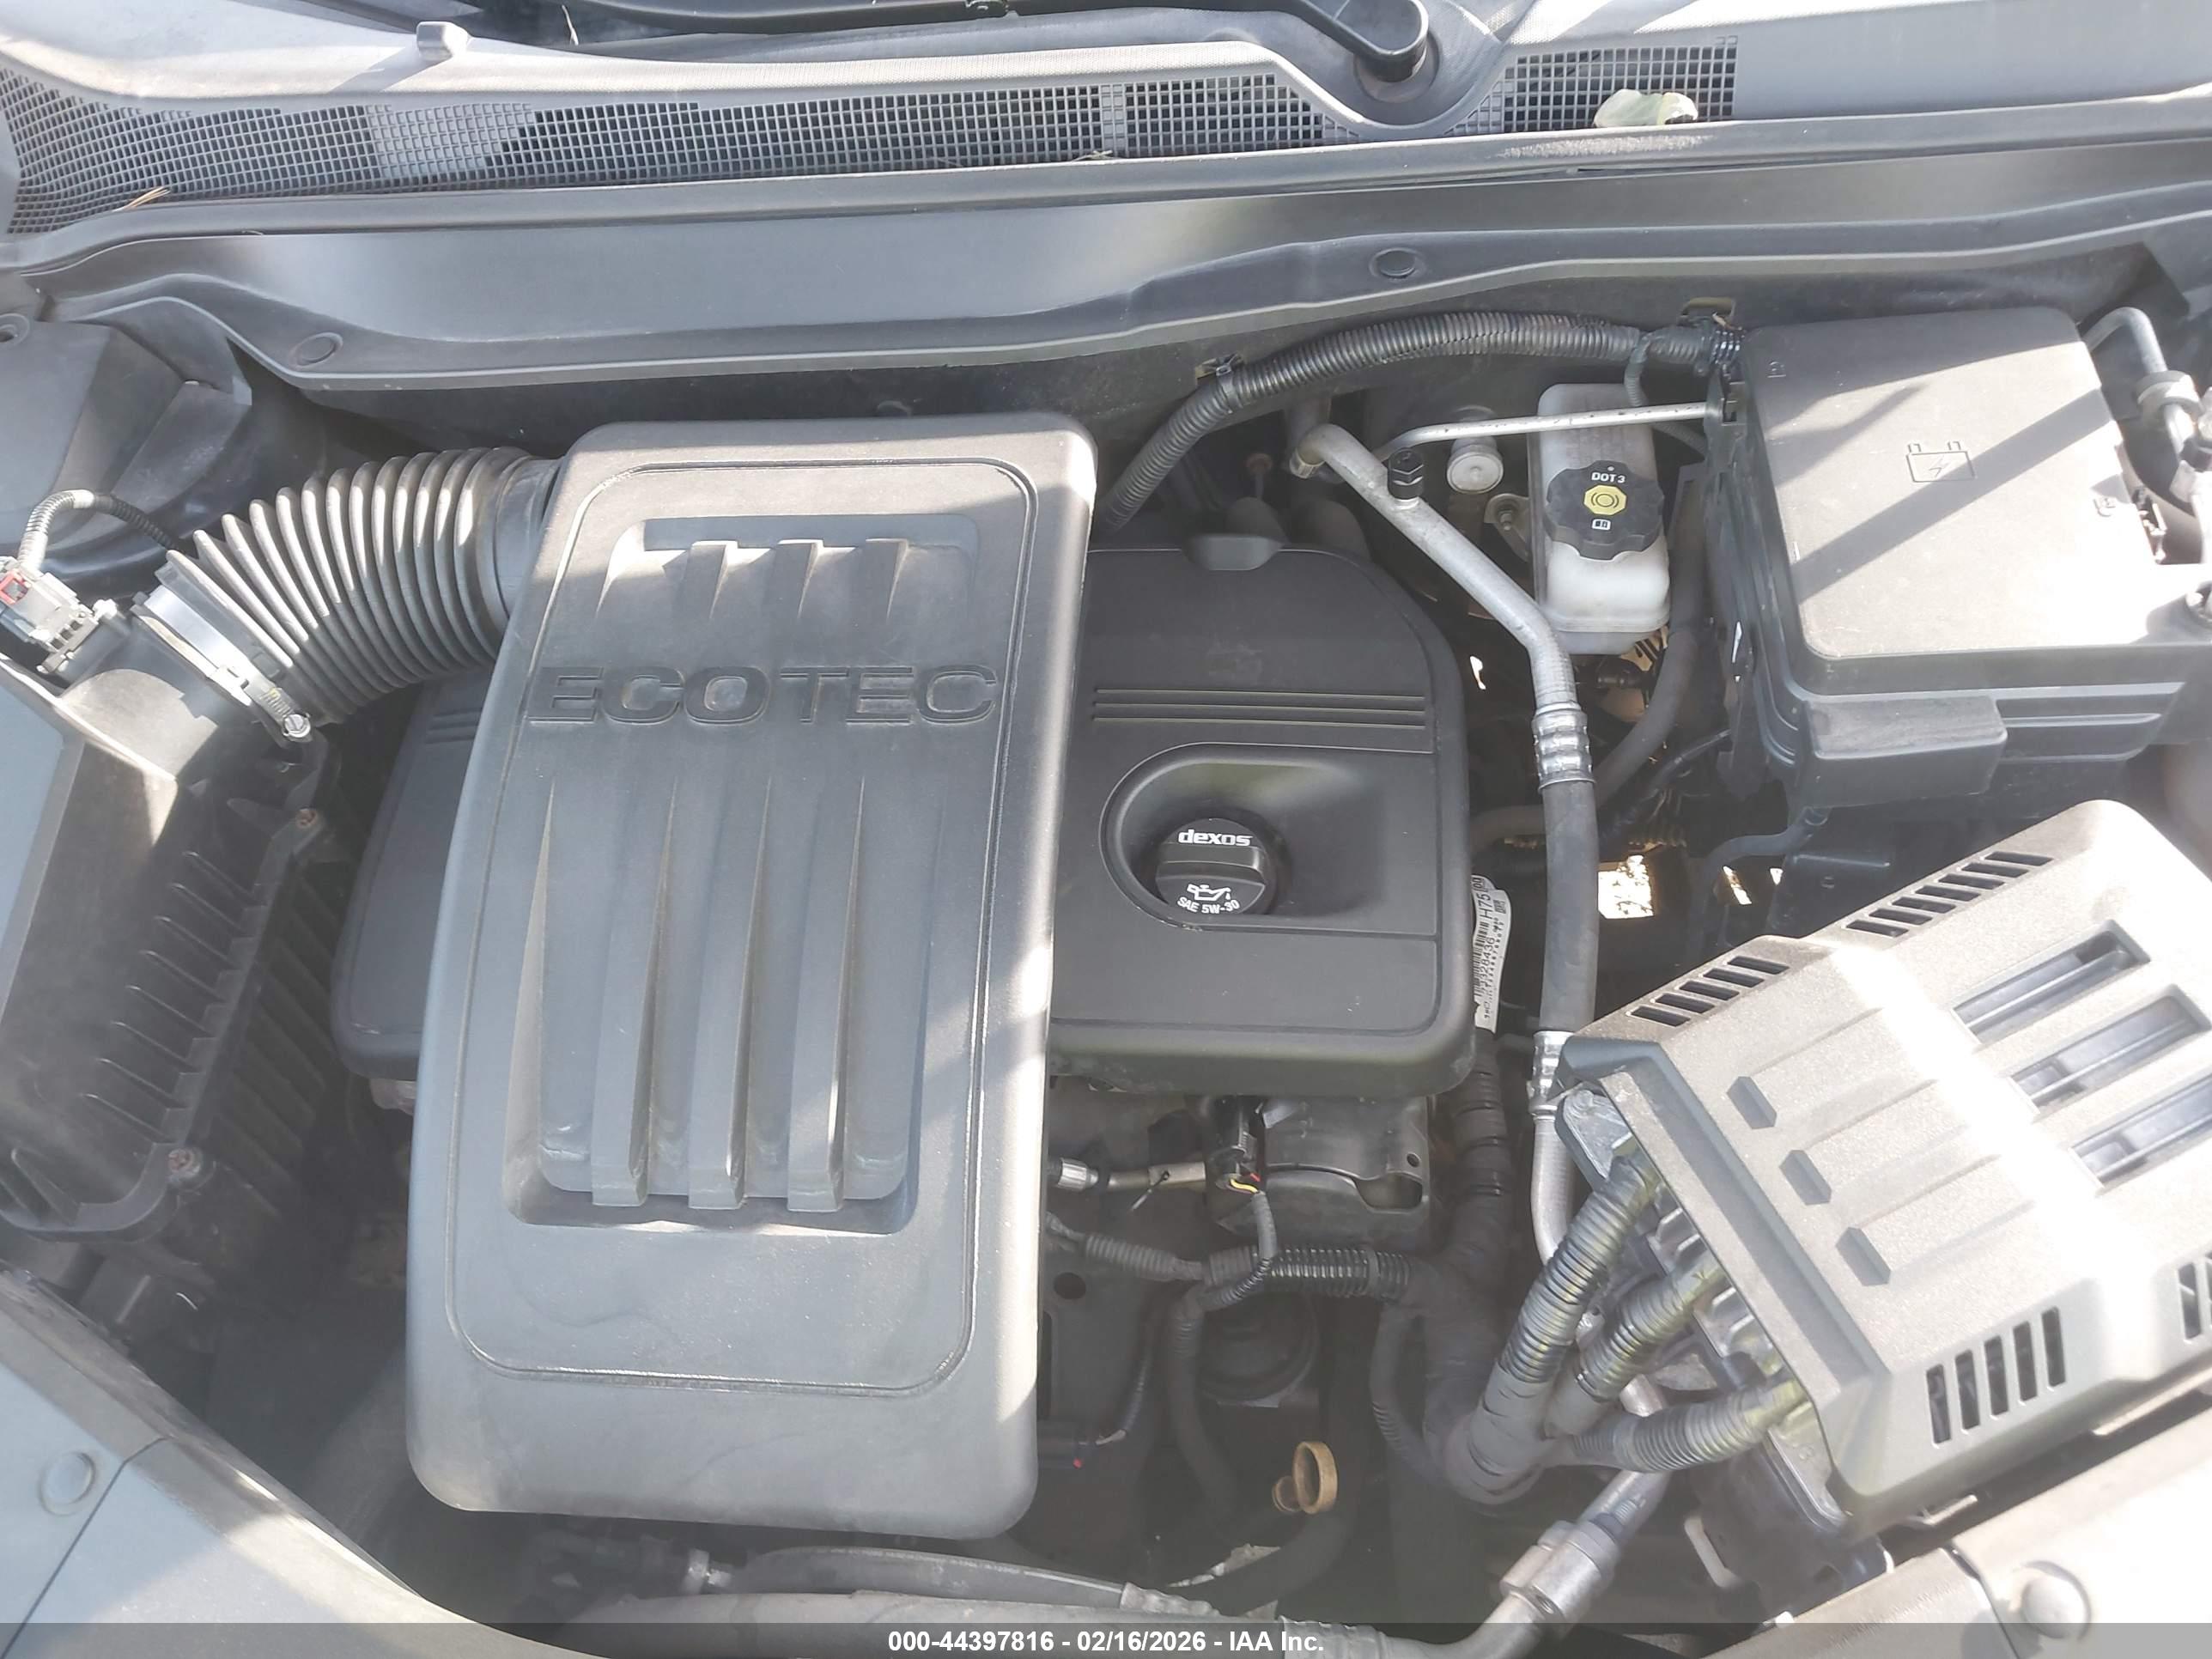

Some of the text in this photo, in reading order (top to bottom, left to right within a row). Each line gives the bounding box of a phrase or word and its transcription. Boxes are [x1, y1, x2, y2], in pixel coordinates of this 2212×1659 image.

[1591, 472, 1626, 483] DOT 3
[529, 665, 997, 726] ECOTEC
[1178, 829, 1254, 847] dexos
[1177, 896, 1240, 914] SAE 5W-30
[1476, 893, 1493, 920] H75
